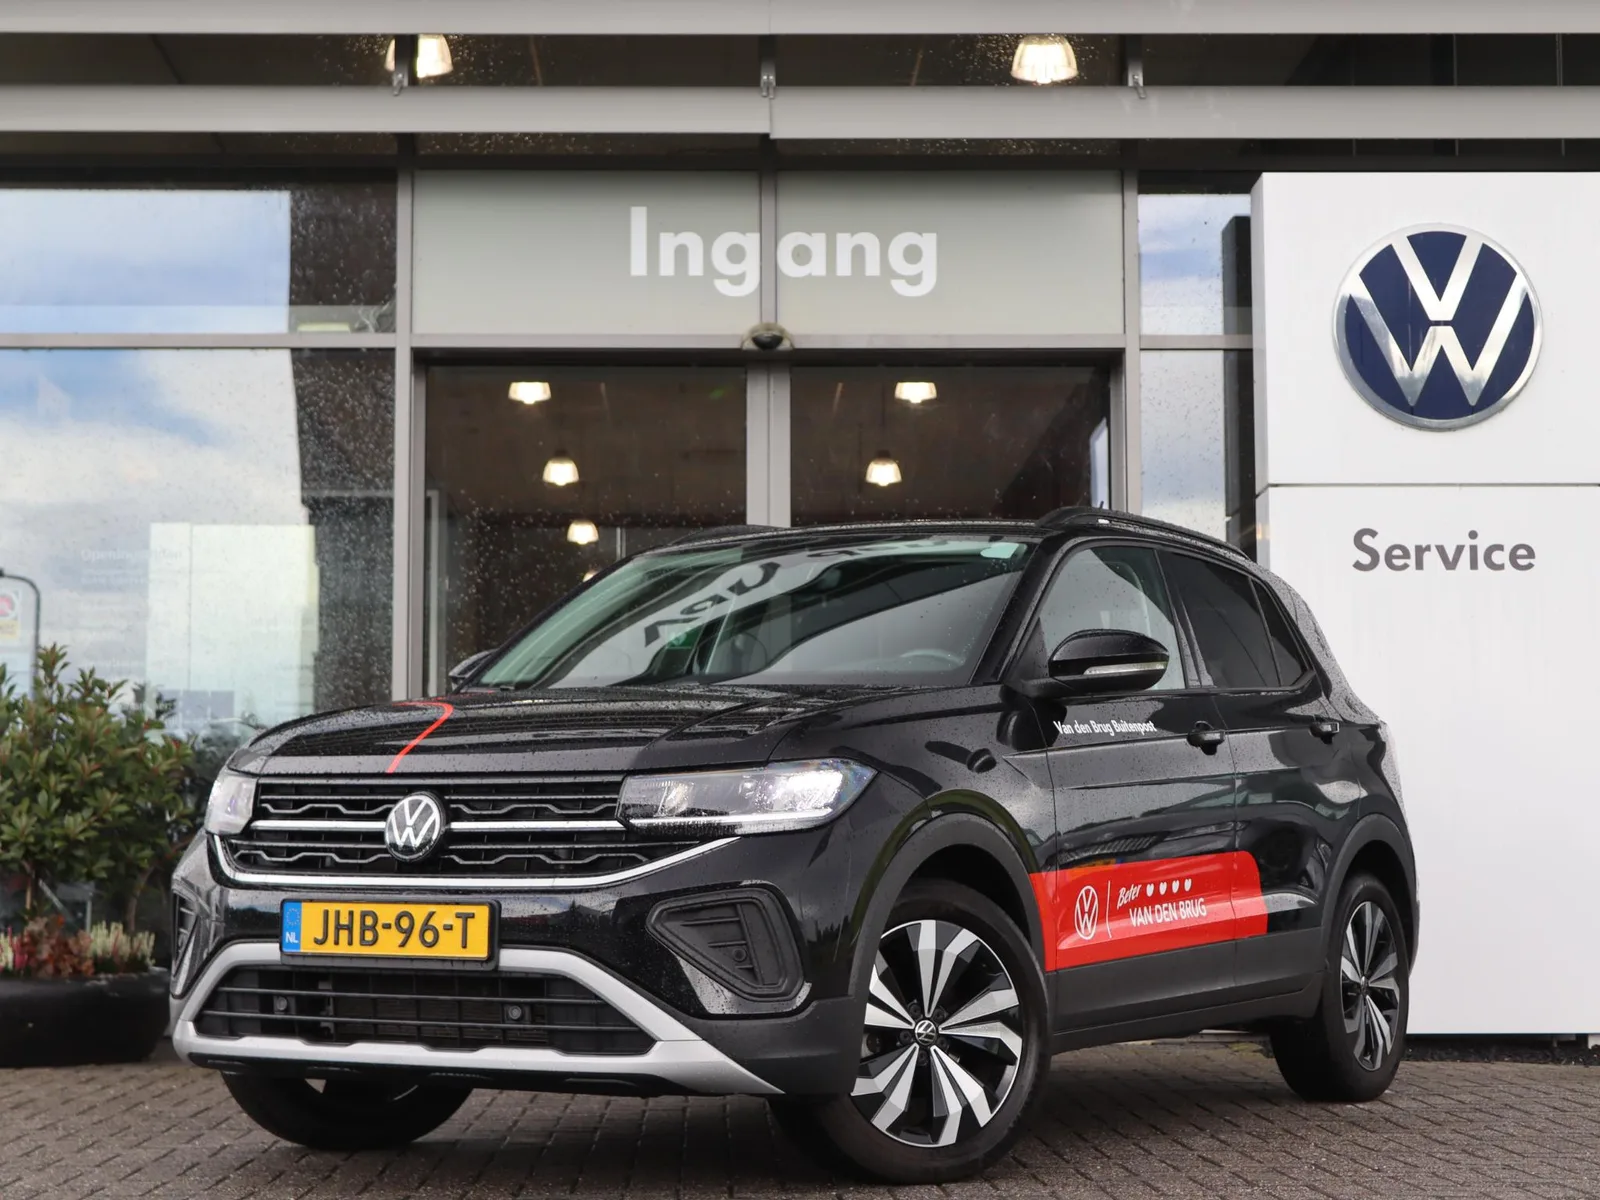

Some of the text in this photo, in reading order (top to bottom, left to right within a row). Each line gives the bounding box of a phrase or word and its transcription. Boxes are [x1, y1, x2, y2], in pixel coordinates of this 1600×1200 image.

[630, 206, 938, 297] Ingang
[1335, 225, 1540, 424] VW
[1352, 527, 1536, 572] Service
[1054, 719, 1158, 737] Van den Brug Buitenpost
[386, 793, 441, 859] VW
[1074, 885, 1098, 940] VW
[1116, 883, 1142, 910] Beter
[1130, 897, 1207, 928] VAN DEN BRUG
[285, 931, 299, 944] NL
[313, 908, 475, 949] JHB-96-T
